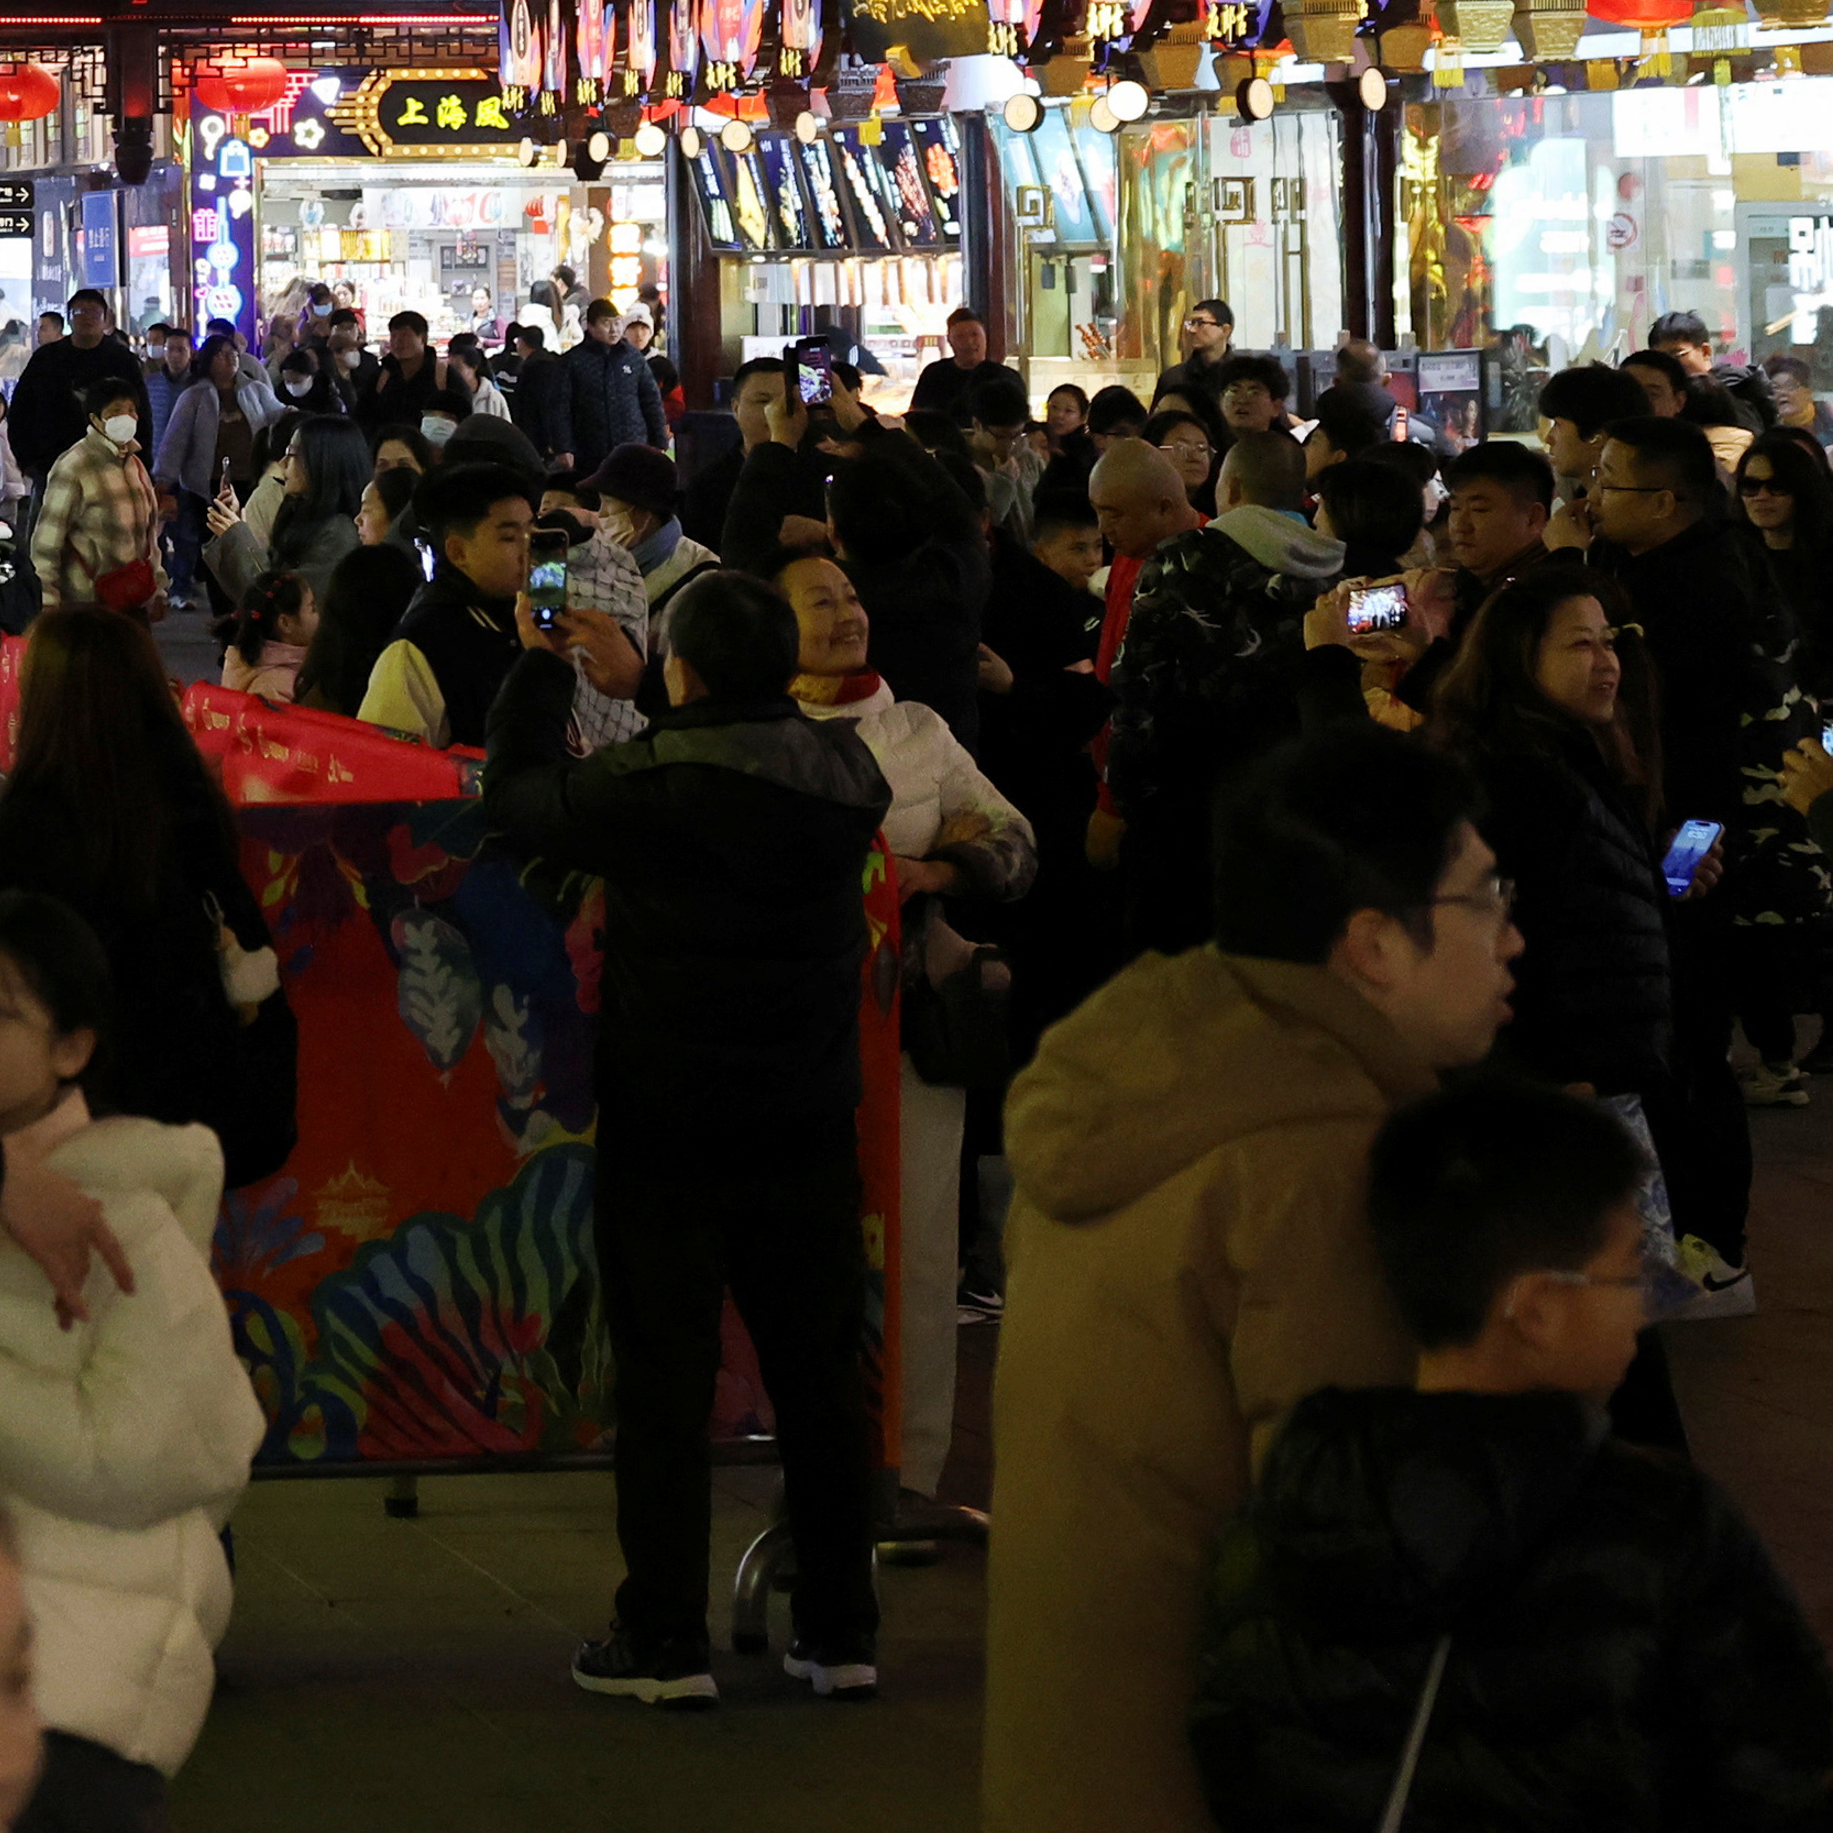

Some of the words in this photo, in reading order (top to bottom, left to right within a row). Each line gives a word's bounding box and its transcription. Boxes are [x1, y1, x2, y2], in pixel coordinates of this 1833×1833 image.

[1086, 2, 1124, 41] 夜郎古
[1205, 3, 1248, 43] 夜郎古
